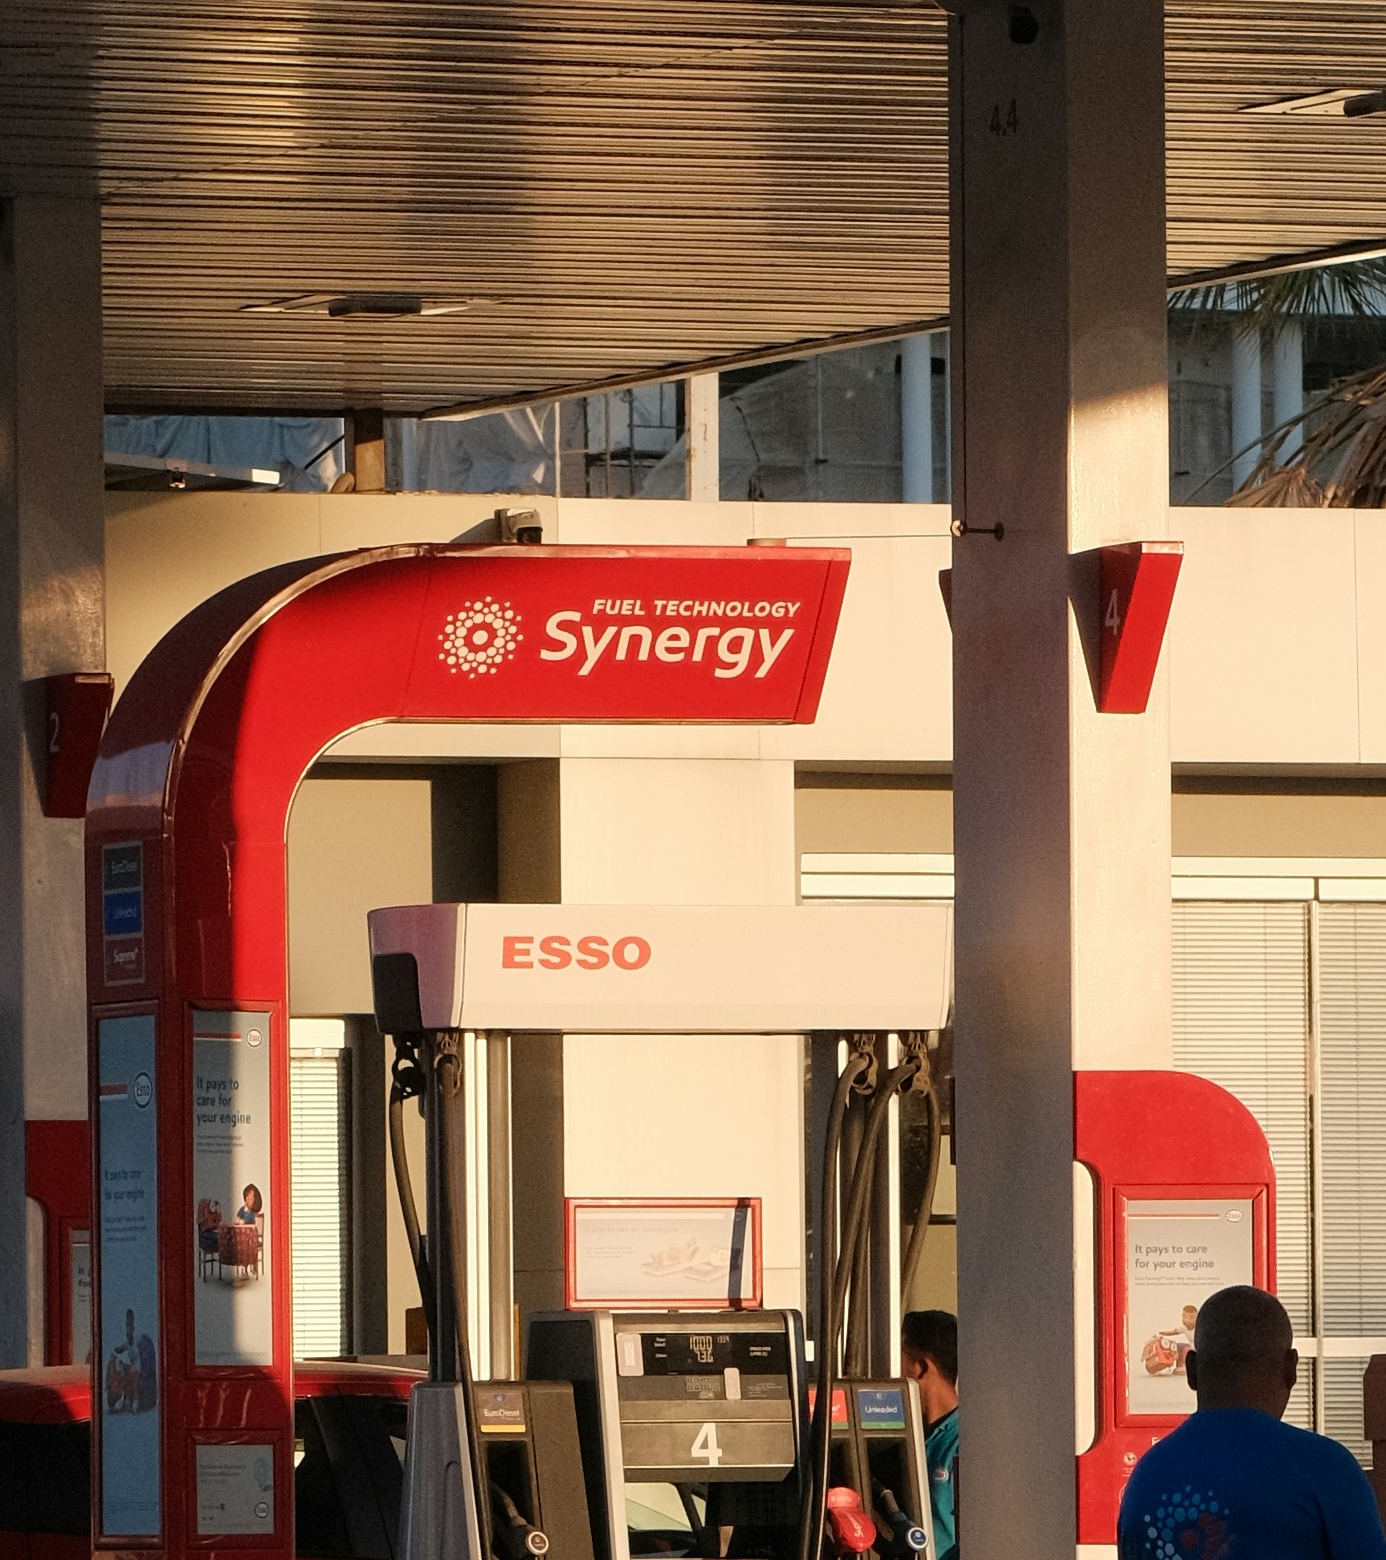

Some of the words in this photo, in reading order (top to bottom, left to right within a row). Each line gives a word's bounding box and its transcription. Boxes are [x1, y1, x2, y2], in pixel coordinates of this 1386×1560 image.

[592, 599, 645, 616] FUEL
[654, 600, 801, 618] TECHNOLOGY
[1104, 589, 1121, 636] 4
[540, 611, 795, 678] Synergy
[49, 712, 60, 753] 2
[502, 935, 652, 971] ESSO
[206, 1081, 228, 1092] pays
[196, 1096, 216, 1107] care
[218, 1093, 232, 1107] for
[196, 1113, 218, 1127] your
[219, 1110, 252, 1128] engine
[1135, 1244, 1144, 1255] It
[1146, 1246, 1170, 1257] pays
[1172, 1245, 1184, 1255] to
[1186, 1246, 1209, 1255] care
[1135, 1258, 1150, 1269] for
[1152, 1260, 1177, 1272] your
[1179, 1258, 1215, 1272] engine
[864, 1405, 898, 1414] Unleaded
[690, 1423, 723, 1466] 4
